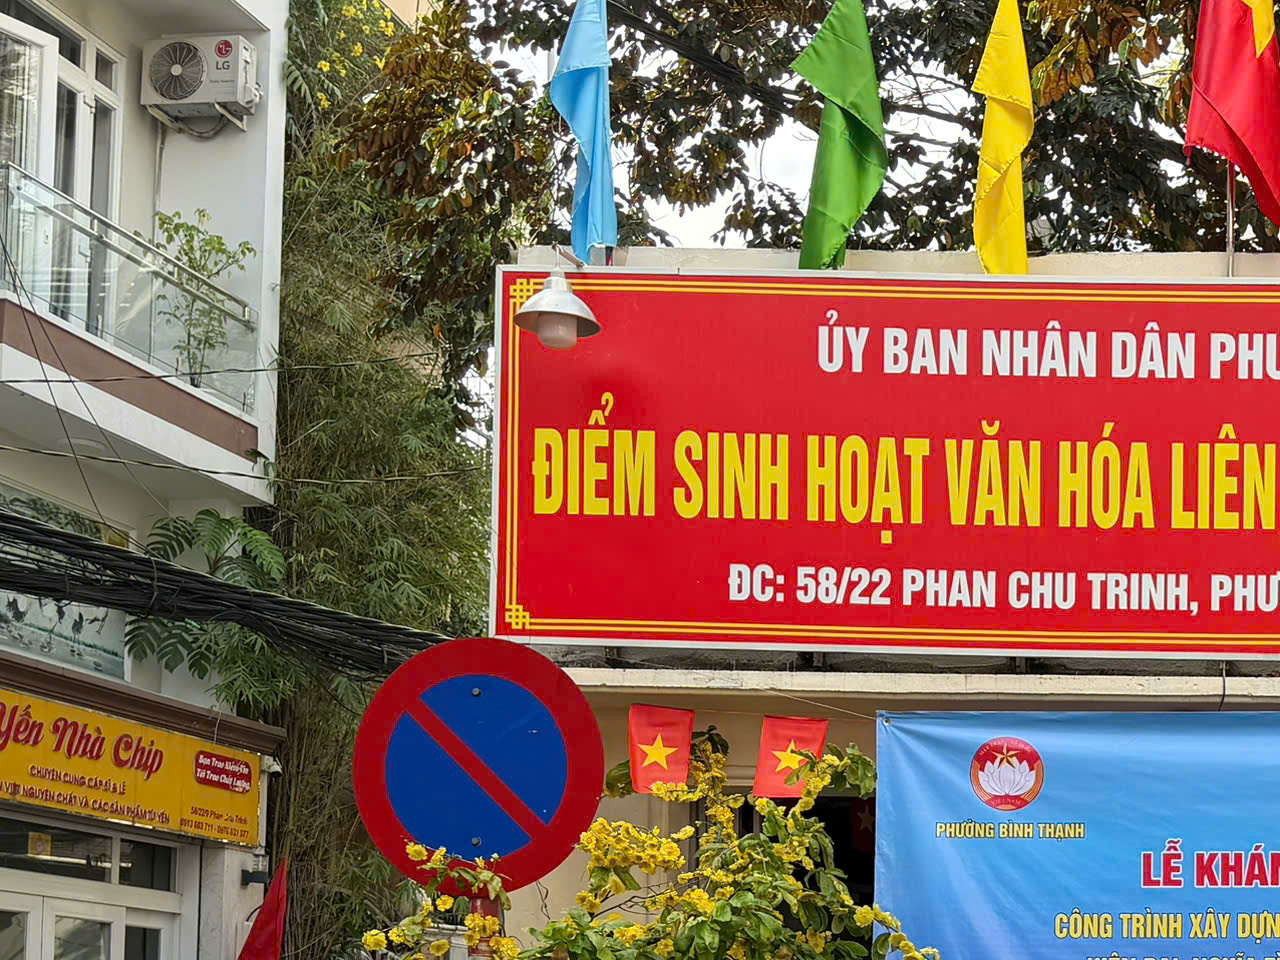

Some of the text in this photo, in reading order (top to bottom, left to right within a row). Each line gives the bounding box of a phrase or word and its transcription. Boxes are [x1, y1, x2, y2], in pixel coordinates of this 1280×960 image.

[216, 61, 230, 70] LG
[819, 310, 869, 372] ỦY
[884, 328, 967, 375] BAN
[983, 321, 1096, 377] NHÂN
[1112, 322, 1195, 378] DÂN
[533, 392, 655, 516] ĐIỂM
[674, 431, 788, 520] SINH
[807, 436, 929, 543] HOẠT
[945, 421, 1040, 526] VĂN
[1059, 423, 1154, 529] HÓA
[1172, 424, 1276, 529] LIÊN
[728, 564, 784, 601] ĐC:
[797, 567, 891, 604] 58/22
[903, 569, 996, 607] PHAN
[1009, 571, 1076, 609] CHU
[1088, 573, 1198, 615] TRINH,
[0, 702, 164, 781] Yến Nhà Chip
[62, 771, 86, 786] CUNG
[936, 818, 1084, 842] PHƯỜNG BÌNH THẠNH
[1141, 838, 1184, 889] LỄ
[1055, 908, 1113, 939] CÔNG
[1120, 908, 1182, 938] TRÌNH
[1189, 908, 1230, 938] XÂY
